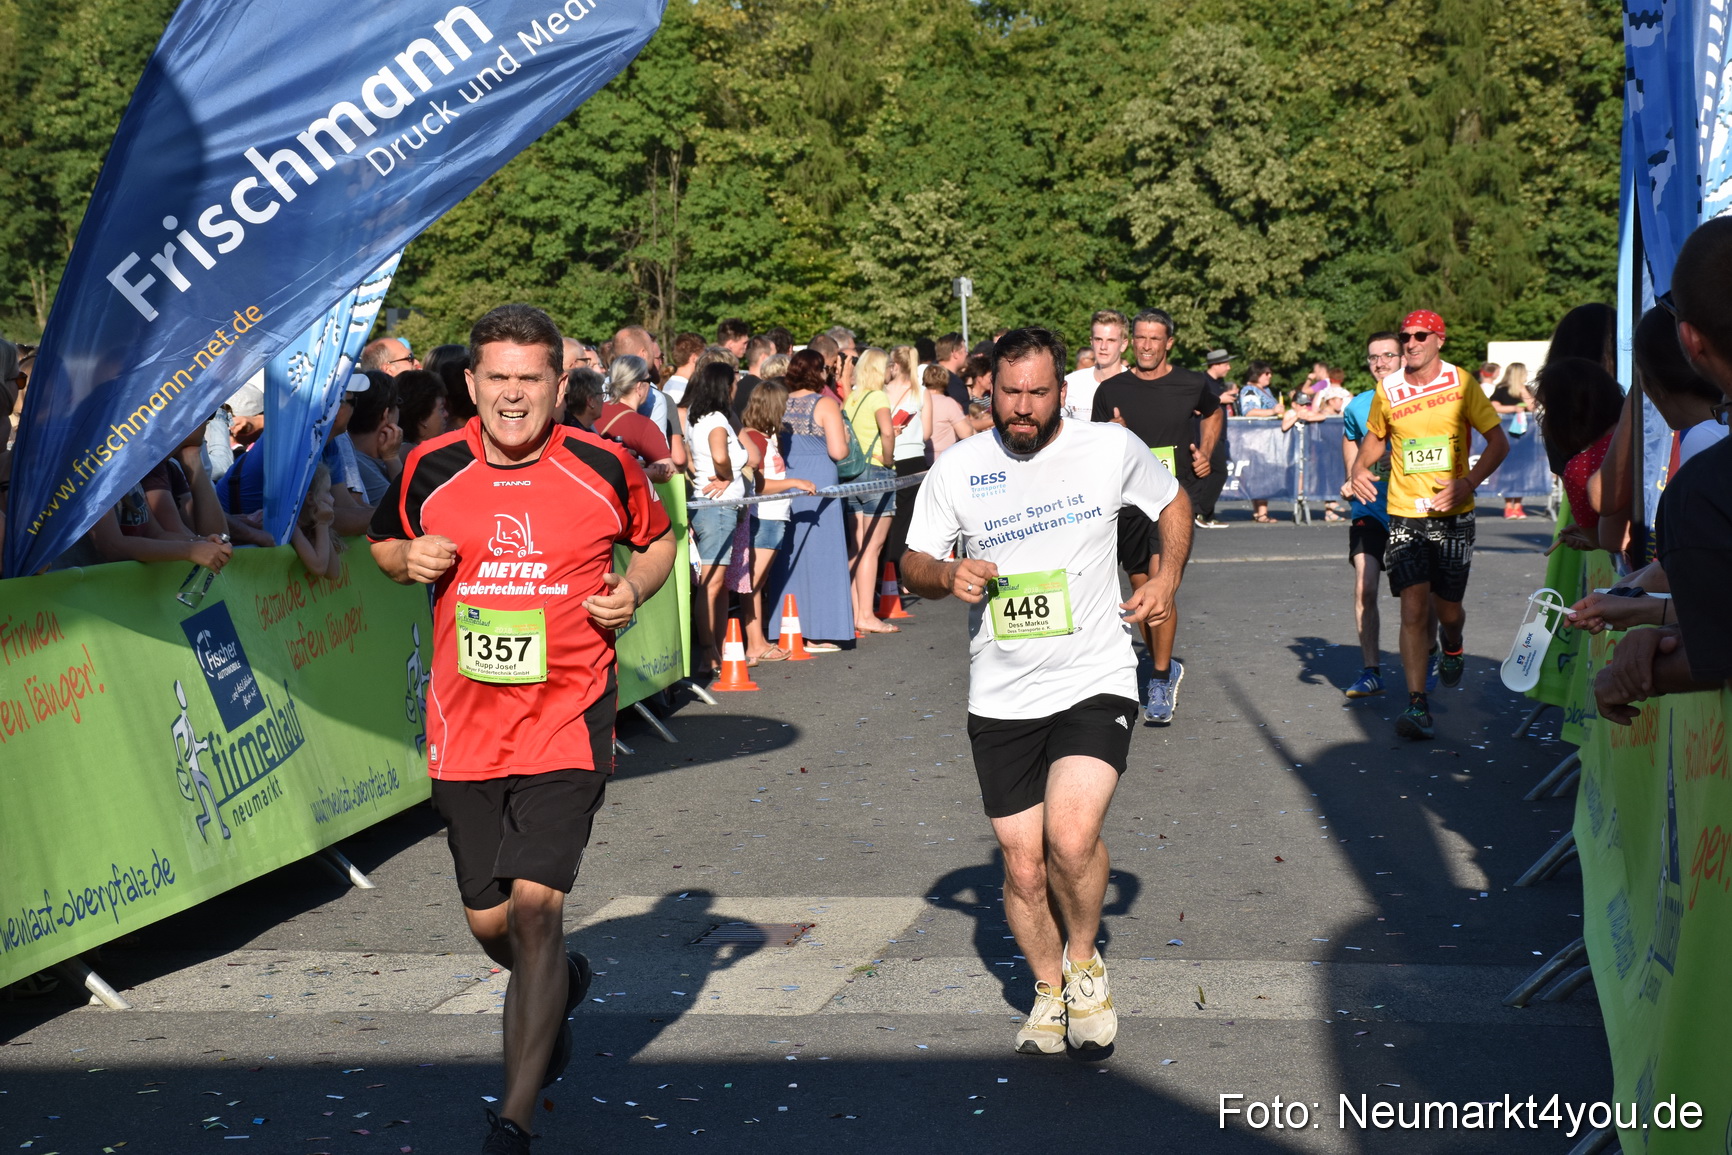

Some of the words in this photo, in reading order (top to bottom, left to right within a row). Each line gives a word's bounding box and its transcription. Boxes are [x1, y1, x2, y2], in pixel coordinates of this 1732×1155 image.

[365, 100, 460, 177] Druck
[458, 45, 521, 104] und
[106, 5, 494, 322] Frischmann
[27, 305, 264, 536] www.frischmann-net.de
[1392, 403, 1423, 422] MAX
[1427, 391, 1463, 409] BÖGL
[1408, 448, 1443, 463] 1347
[970, 471, 1006, 486] DESS
[971, 483, 1006, 493] Transporte
[972, 489, 1006, 498] Logistik
[978, 506, 1102, 550] SchüttguttranSport
[984, 512, 1022, 531] Unser
[1026, 499, 1064, 518] Sport
[1067, 494, 1085, 506] ist
[477, 561, 548, 579] MEYER
[456, 581, 536, 596] Fördertechnik
[538, 583, 569, 595] GmbH
[1004, 595, 1050, 620] 448
[1025, 619, 1049, 627] Markus
[0, 611, 65, 666] Firmen
[464, 631, 532, 662] 1357
[205, 641, 237, 671] Fischer
[217, 660, 241, 680] AUTOMOBILE
[475, 660, 494, 670] Rupp
[24, 643, 104, 724] länger!
[207, 679, 305, 799] firmenlauf
[232, 775, 283, 827] neumarkt
[0, 848, 175, 956] menlauf-oberpfalz.de
